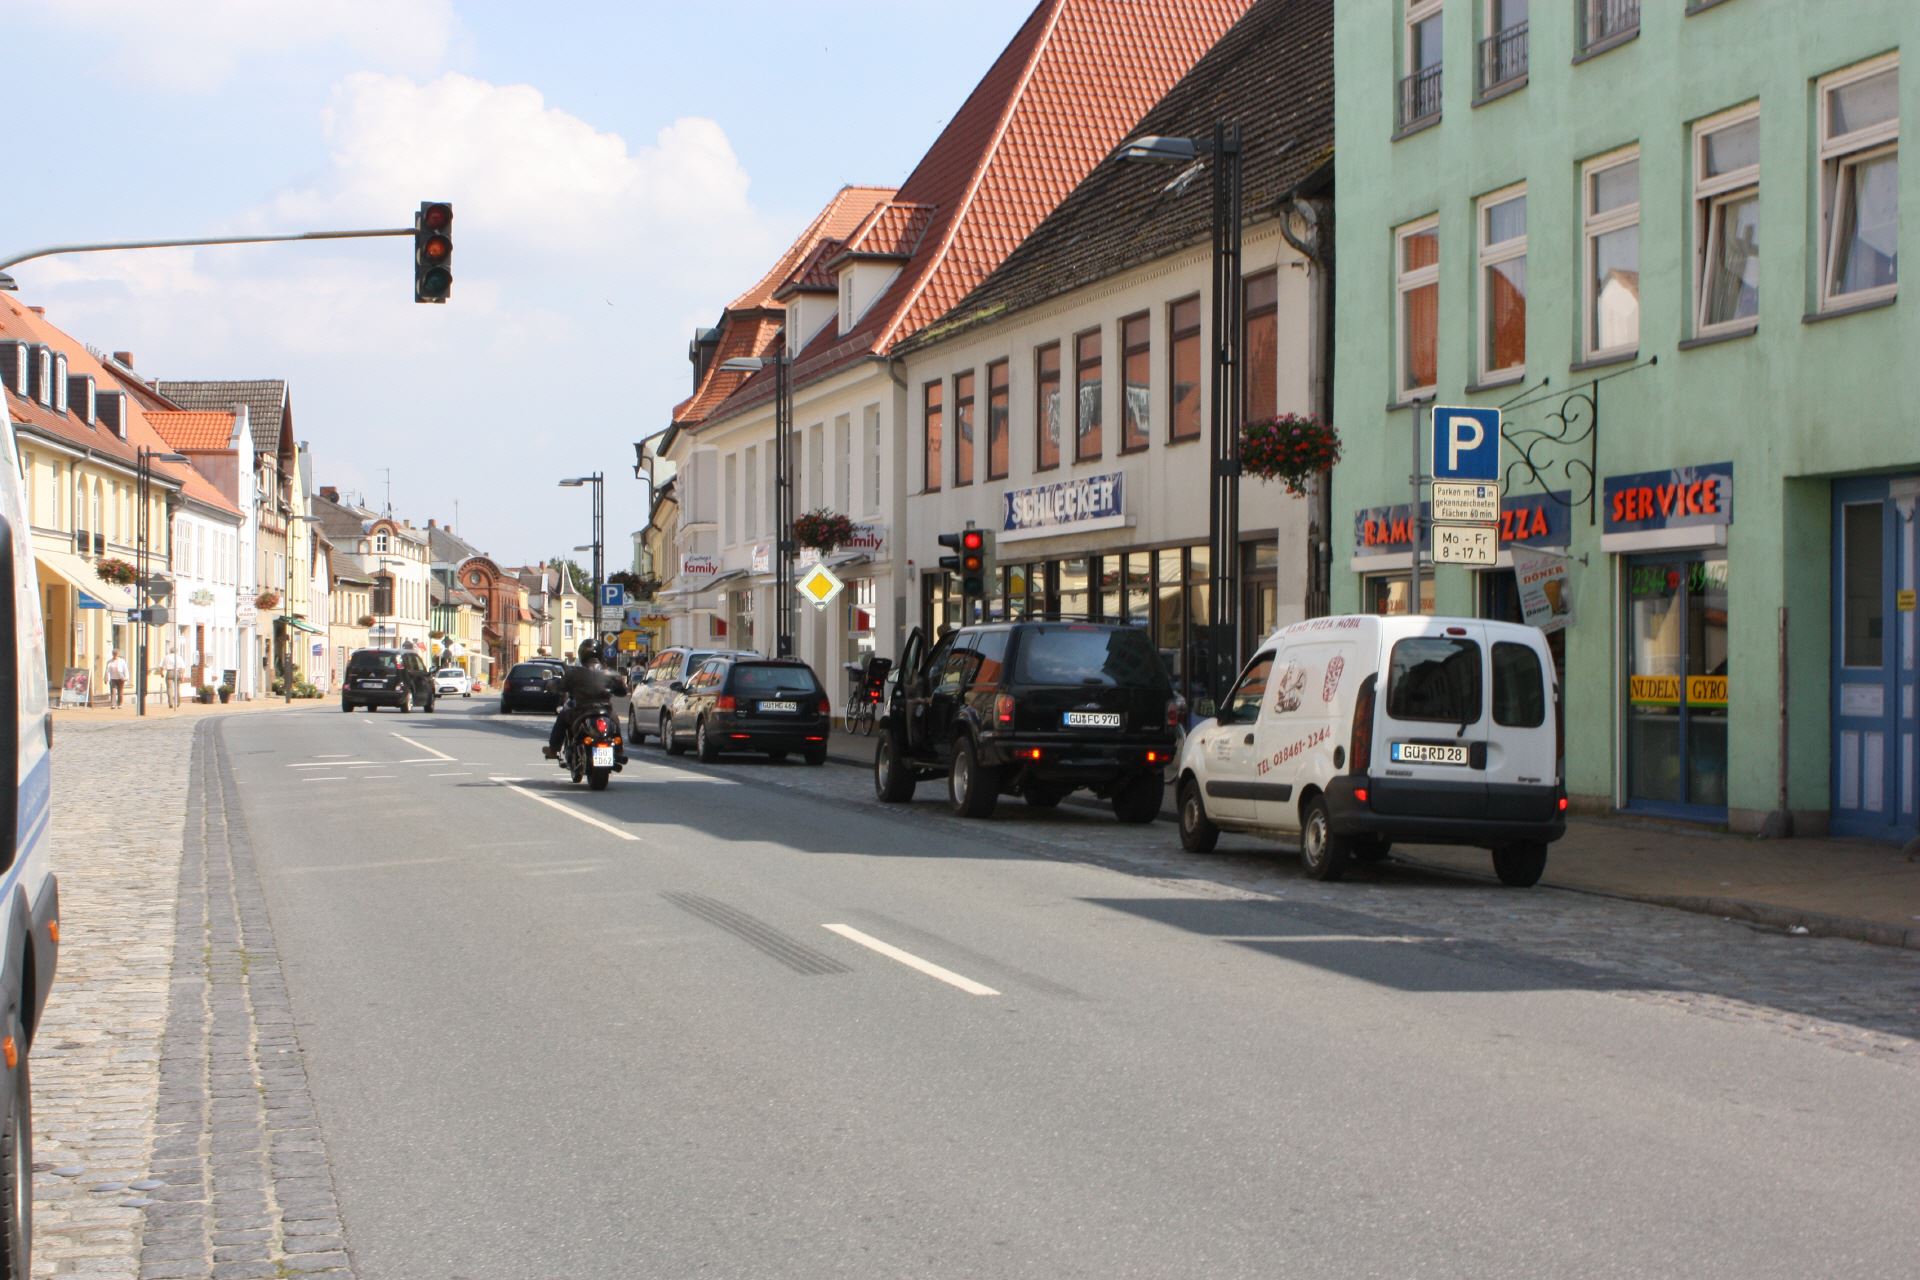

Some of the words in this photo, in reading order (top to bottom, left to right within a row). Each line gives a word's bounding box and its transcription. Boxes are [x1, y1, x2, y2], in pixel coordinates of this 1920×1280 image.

[1448, 416, 1484, 471] P
[1437, 487, 1461, 497] Parken
[1463, 487, 1475, 497] mit
[1486, 488, 1494, 498] in
[1612, 479, 1718, 523] SERVICE
[1011, 481, 1113, 524] SCHLECKER
[1435, 499, 1496, 509] gekennzeichneten
[1441, 507, 1468, 518] Flächen
[1470, 508, 1479, 518] 60
[845, 533, 884, 551] amily
[1442, 532, 1459, 544] Mo
[1475, 533, 1488, 545] Fr
[1442, 547, 1449, 558] 8
[1478, 548, 1486, 559] h
[684, 561, 718, 575] family
[1523, 565, 1564, 584] DÖNER
[606, 586, 618, 604] P
[1631, 679, 1680, 699] NUDELN
[1692, 680, 1728, 700] GYRO
